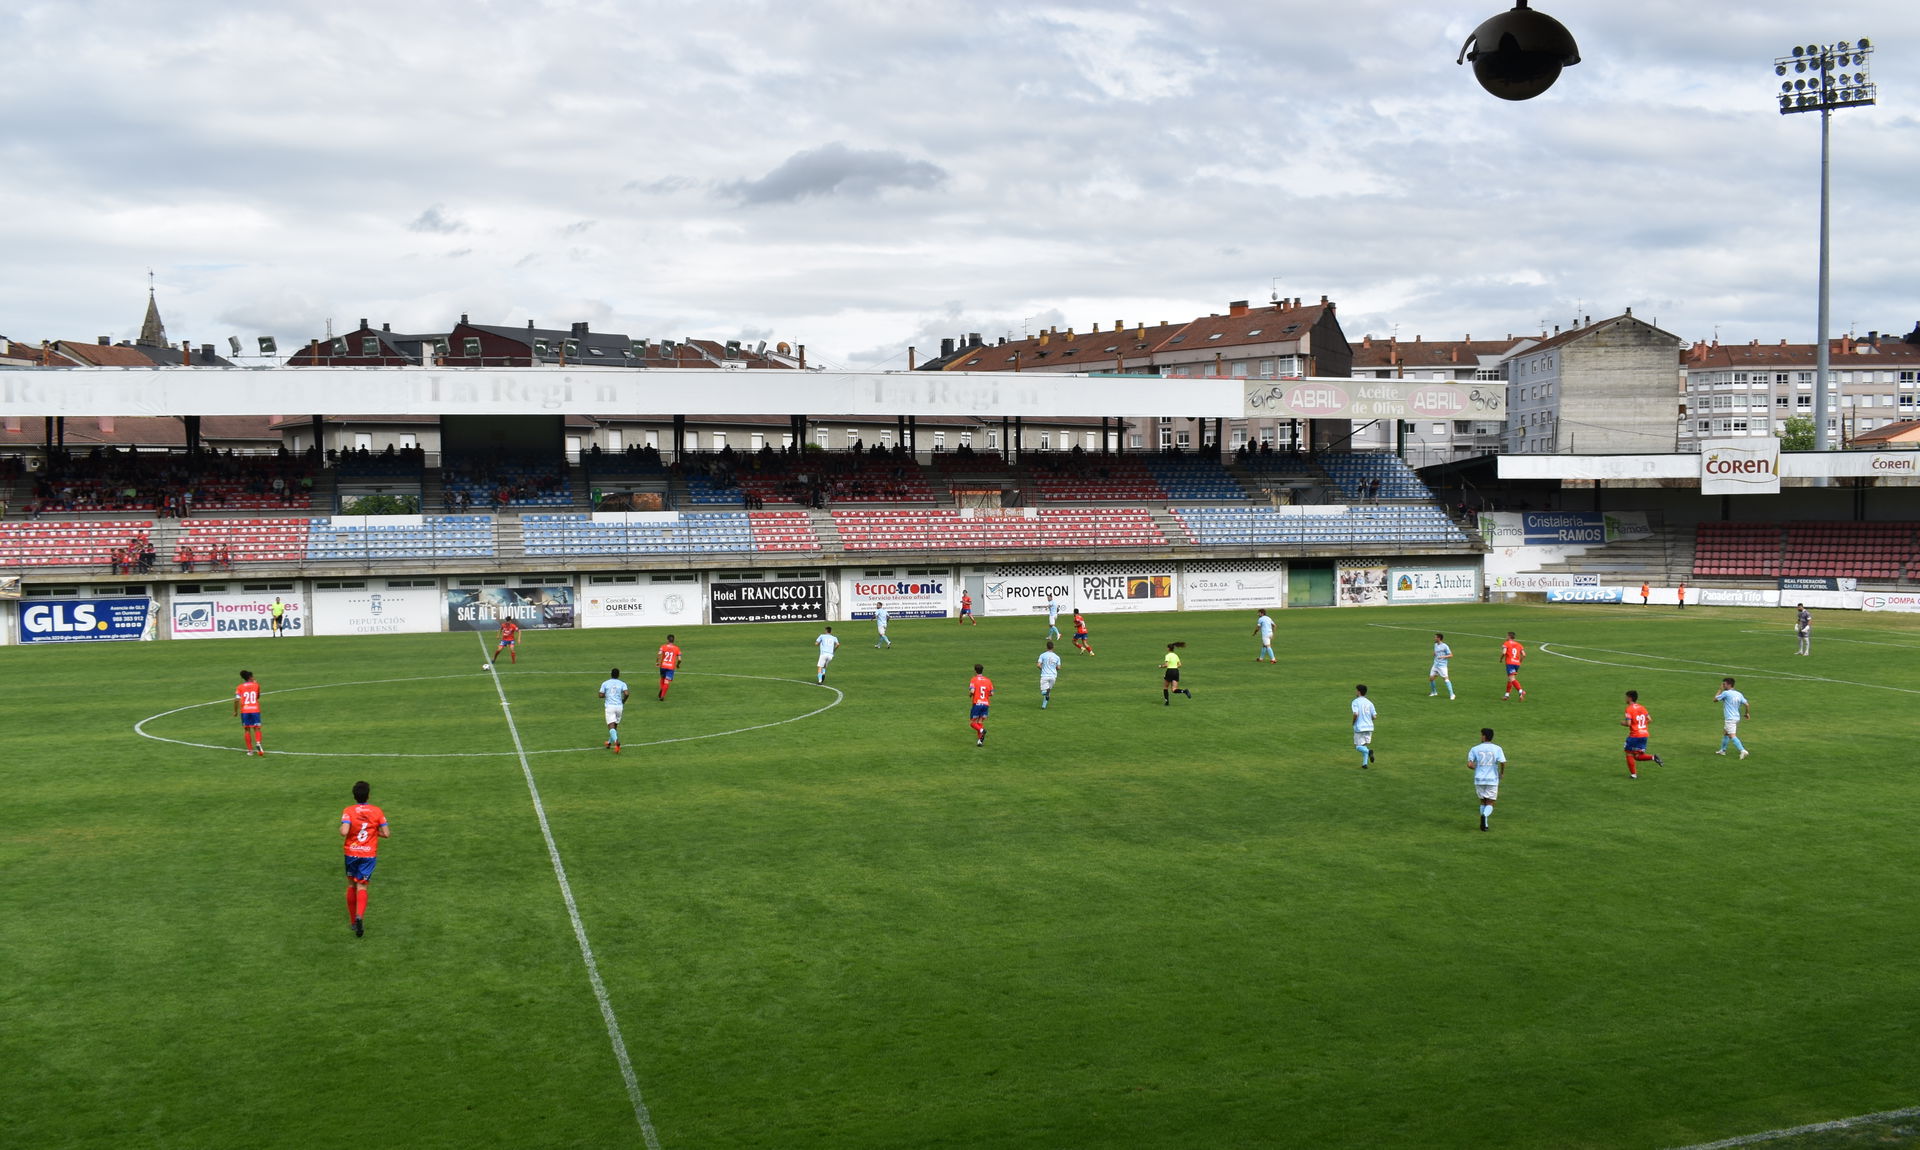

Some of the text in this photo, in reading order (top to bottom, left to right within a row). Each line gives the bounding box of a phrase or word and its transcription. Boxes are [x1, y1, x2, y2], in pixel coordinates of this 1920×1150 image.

[1291, 389, 1342, 409] ABRIL
[1357, 386, 1400, 400] Aceite
[1412, 391, 1463, 410] ABRIL
[1351, 402, 1405, 415] de Oliva
[1487, 523, 1523, 536] Ramos
[1559, 529, 1601, 541] RAMOS
[1083, 576, 1125, 588] PONTE
[1415, 573, 1430, 589] La
[1528, 578, 1537, 587] de
[1539, 577, 1570, 589] Galicia
[713, 585, 822, 601] Hotel FRANCISCO II
[1006, 585, 1069, 598] PROYECON
[1083, 588, 1124, 600] VELLA
[457, 606, 476, 621] SAE
[491, 606, 497, 620] E
[499, 602, 536, 620] MÓVETE
[606, 603, 643, 611] OURENSE
[217, 615, 301, 631] BARBAÁS
[349, 617, 406, 625] DEPUTACIÓN
[720, 613, 818, 621] www.ga-hoteles.es
[664, 652, 673, 662] 21
[1512, 648, 1517, 658] 9
[244, 692, 256, 704] 20
[980, 687, 986, 699] 5
[1478, 752, 1494, 766] 22
